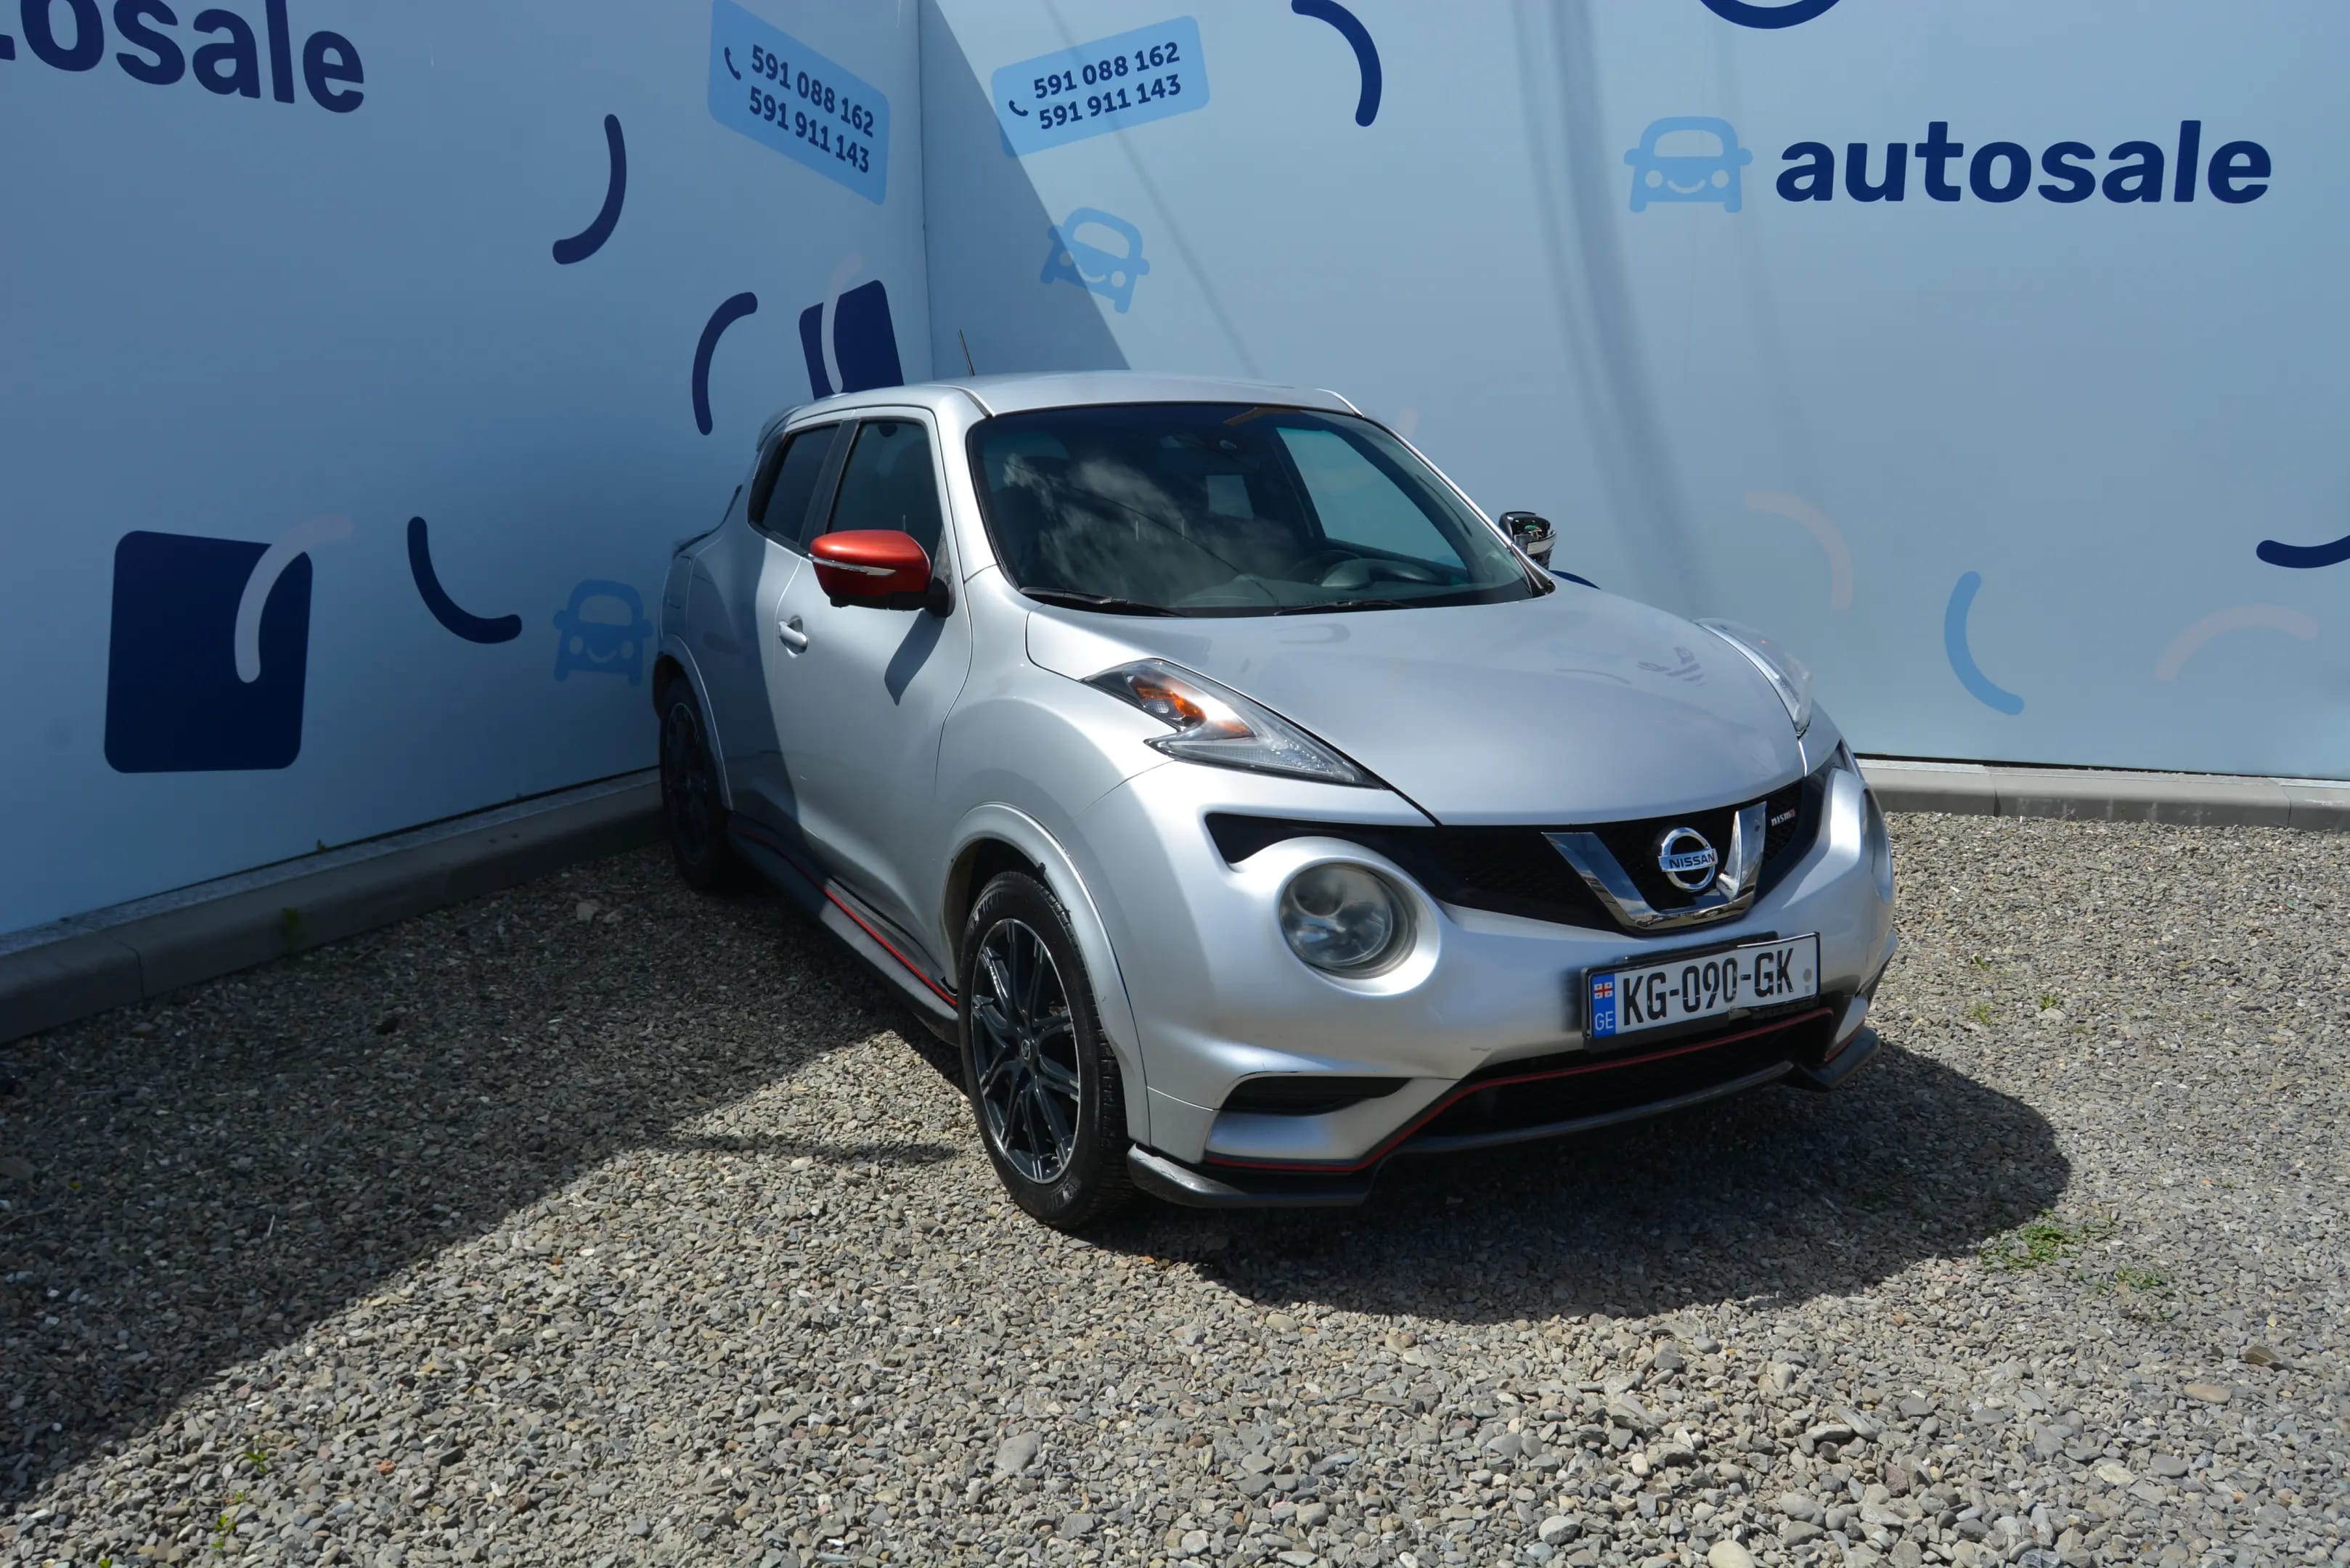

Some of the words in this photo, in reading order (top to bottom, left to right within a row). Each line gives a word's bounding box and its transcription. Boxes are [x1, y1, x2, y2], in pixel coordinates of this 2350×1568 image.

[0, 0, 364, 113] osale
[752, 44, 791, 90] 591
[797, 71, 835, 114] 088
[841, 97, 874, 139] 162
[1034, 70, 1077, 99] 591
[1082, 56, 1128, 86] 088
[1135, 41, 1180, 72] 162
[749, 86, 789, 131] 591
[795, 111, 831, 153] 911
[836, 134, 869, 173] 143
[1040, 101, 1083, 130] 591
[1088, 88, 1131, 117] 911
[1136, 74, 1181, 105] 143
[1776, 120, 2272, 204] autosale
[1668, 852, 1715, 869] NISSAN
[1595, 1010, 1614, 1031] GE
[1623, 947, 1794, 1026] KG-090-GK
